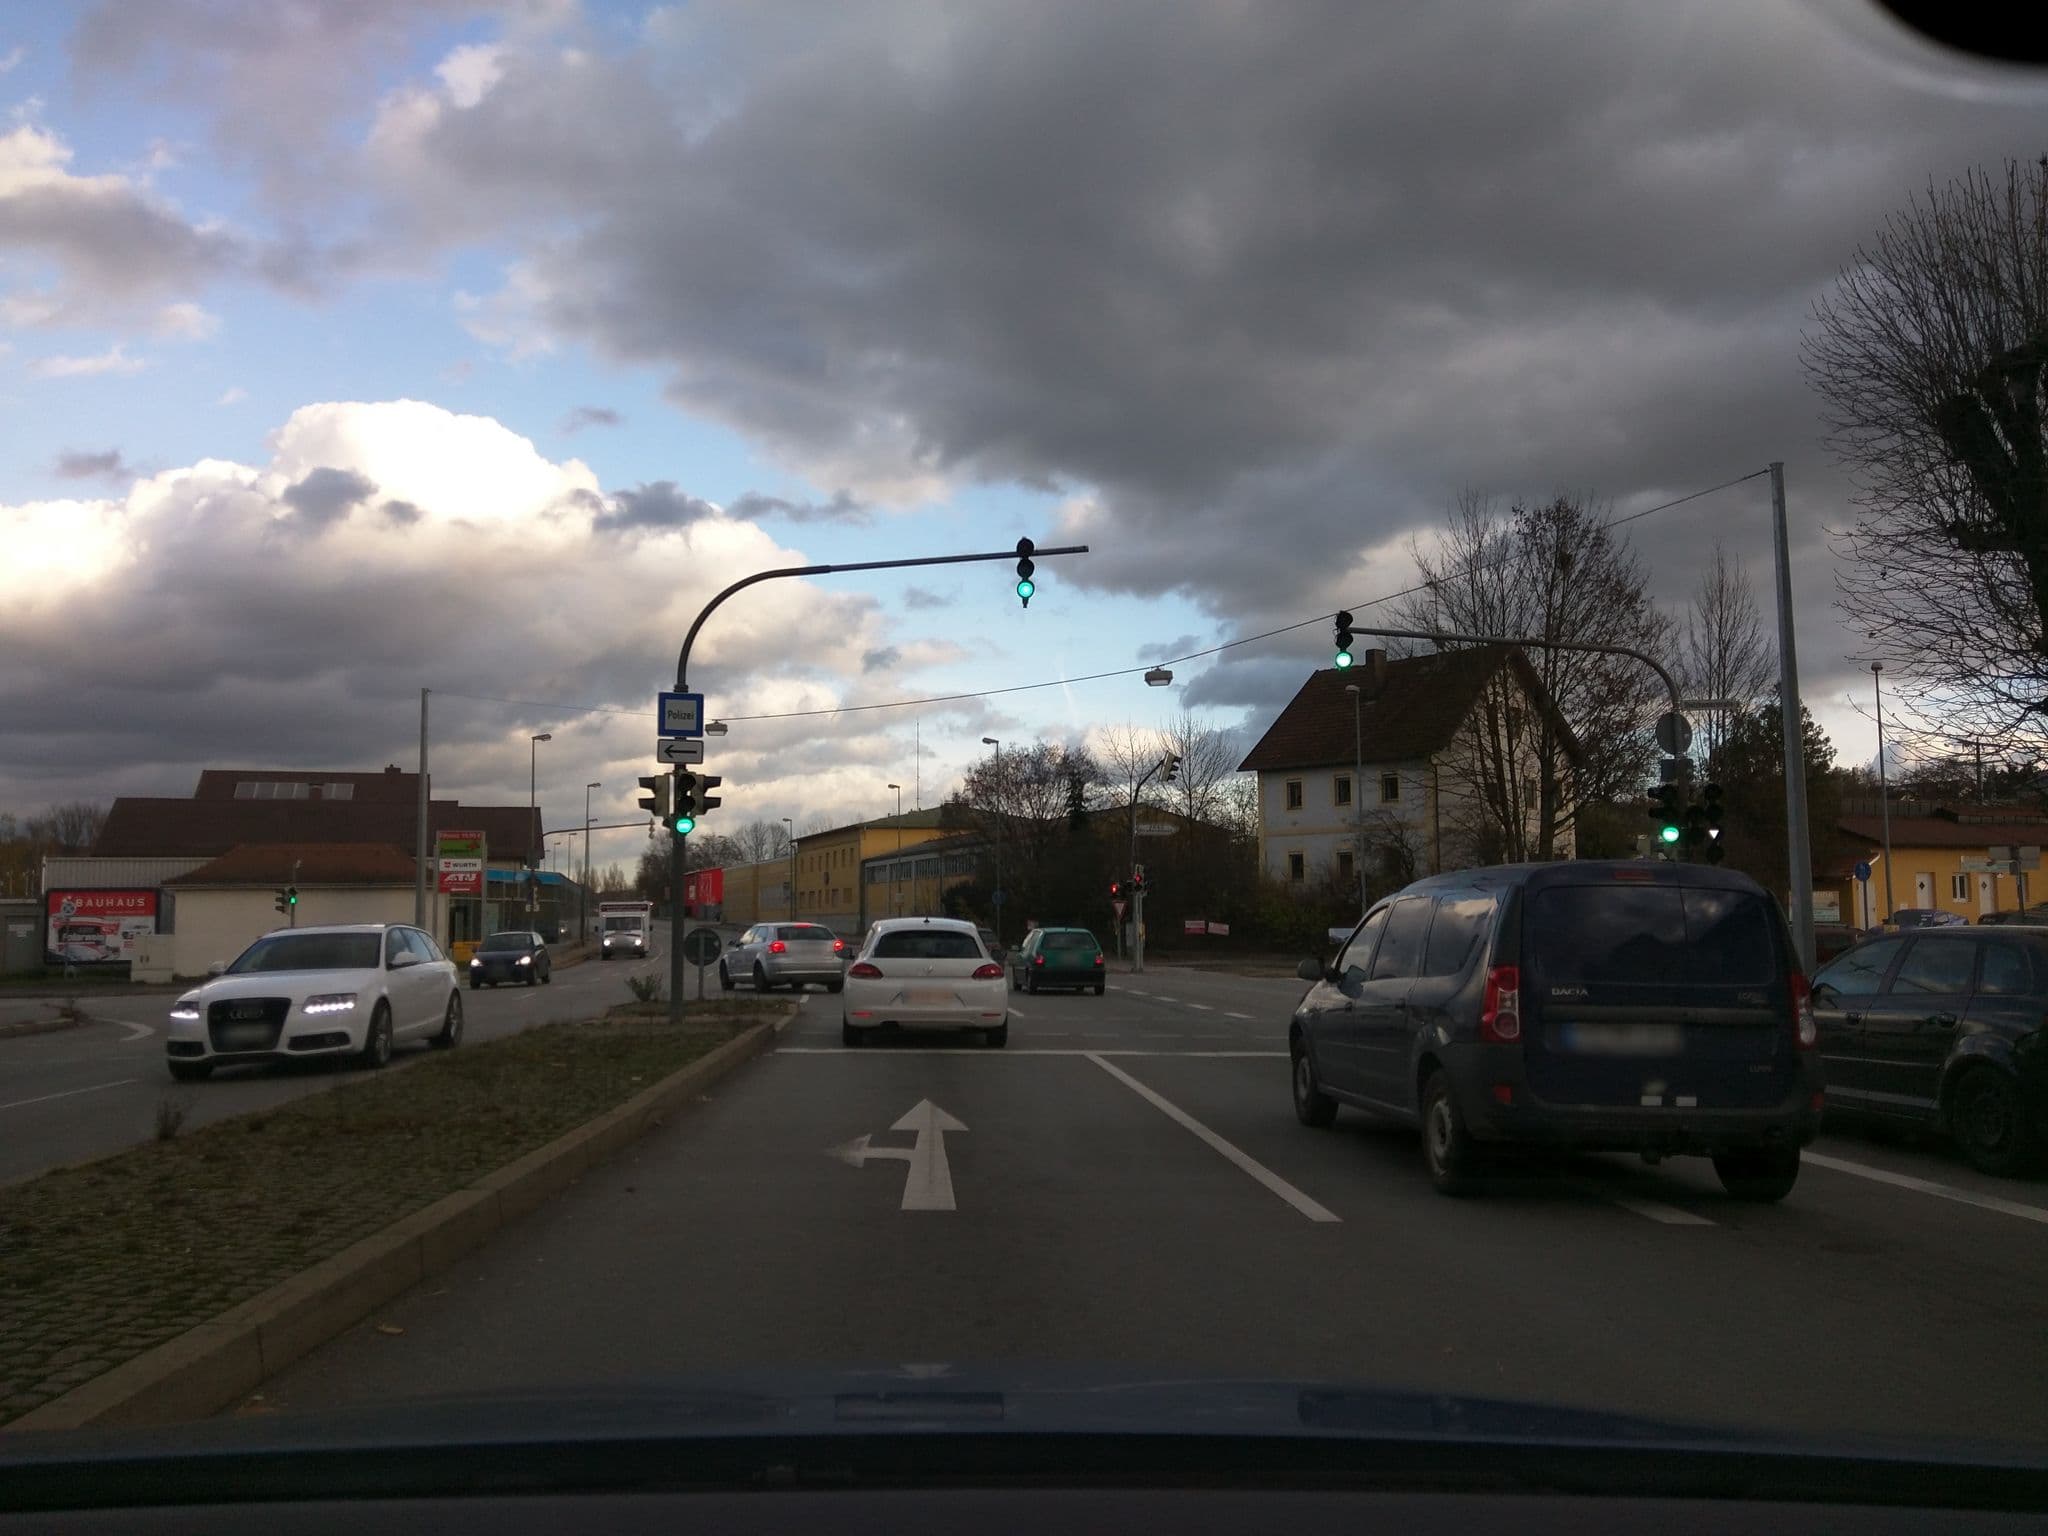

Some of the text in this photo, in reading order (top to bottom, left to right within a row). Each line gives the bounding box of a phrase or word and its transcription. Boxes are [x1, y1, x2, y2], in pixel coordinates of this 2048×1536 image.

[667, 710, 694, 720] Polizei
[75, 898, 145, 907] BAUHAUS
[1551, 987, 1589, 996] DACIA
